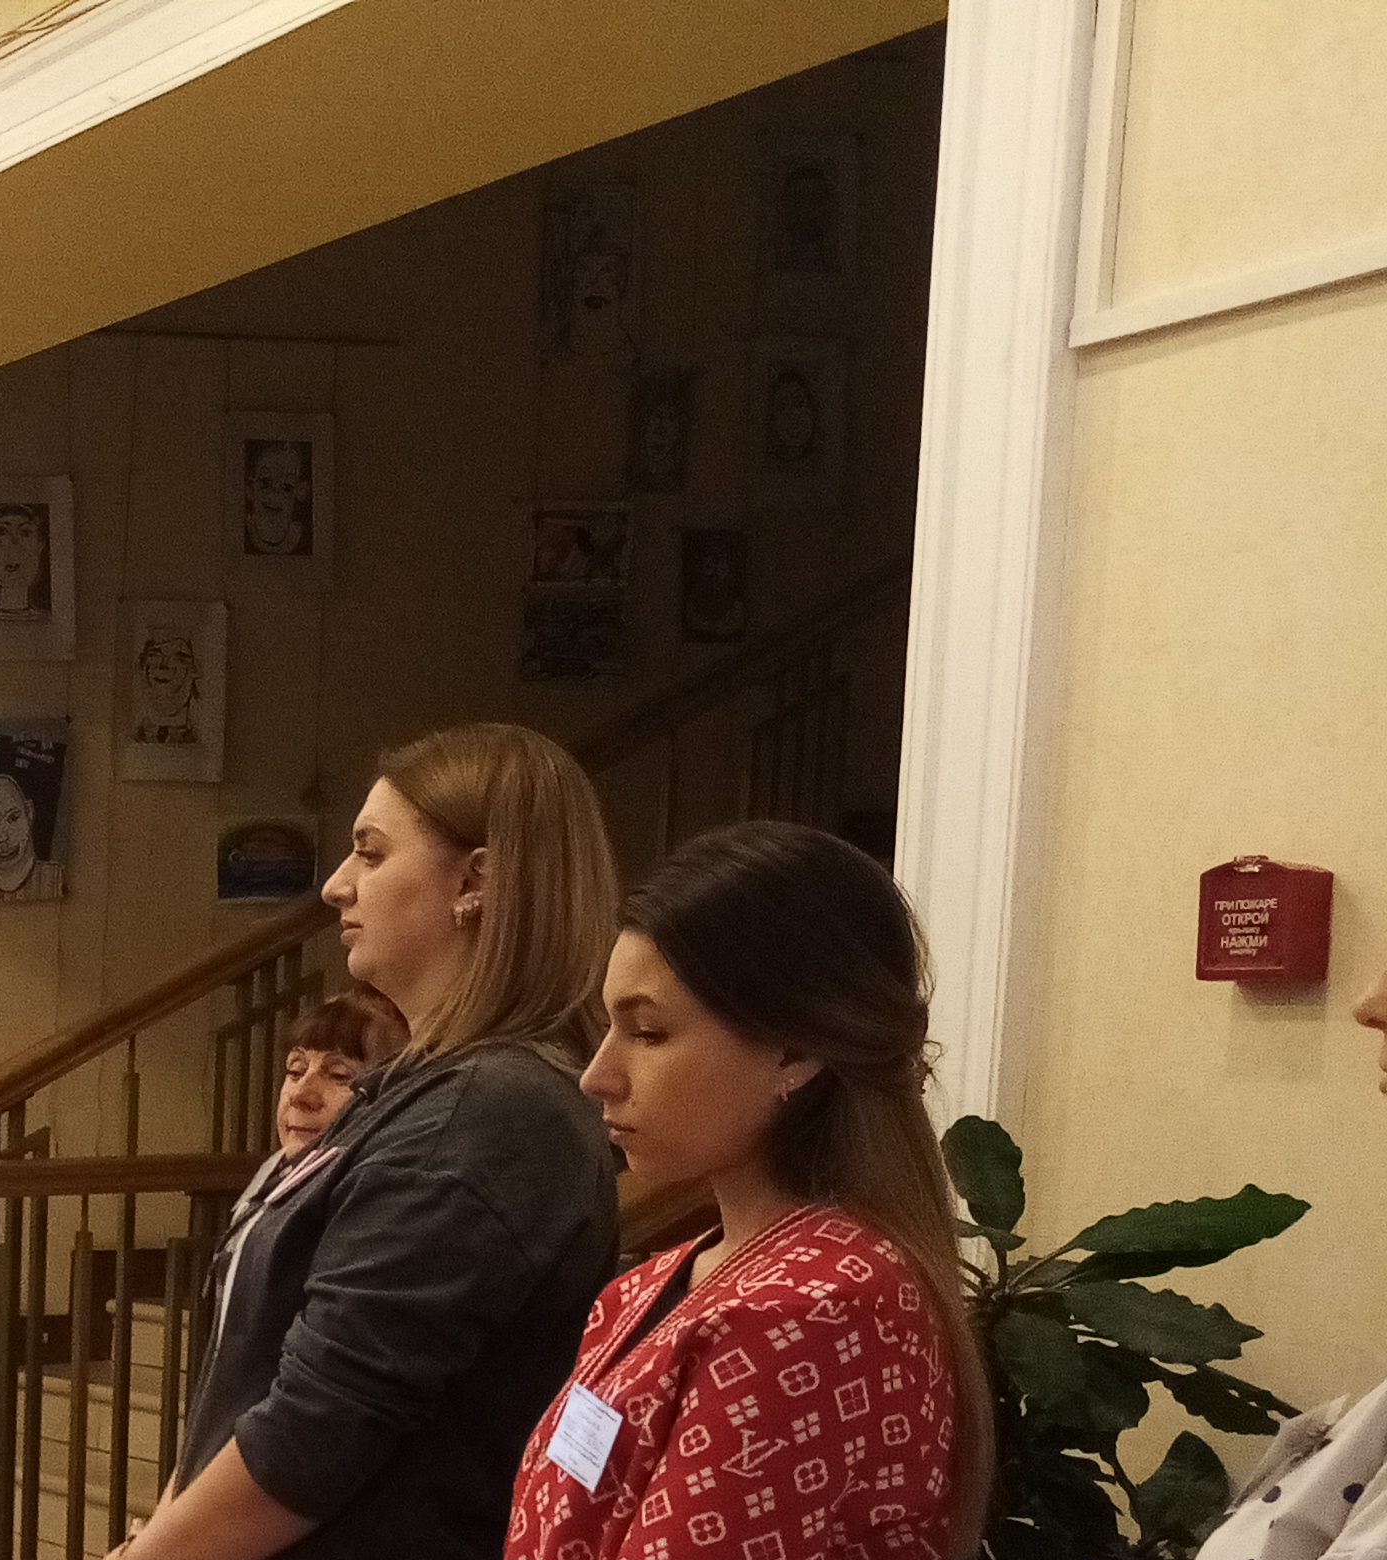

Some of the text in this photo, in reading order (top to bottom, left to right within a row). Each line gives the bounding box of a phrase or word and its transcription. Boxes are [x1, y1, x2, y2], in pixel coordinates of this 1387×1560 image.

[1214, 898, 1278, 911] ПРИ ПОЖАРЕ
[1220, 935, 1268, 948] НАЖМИ
